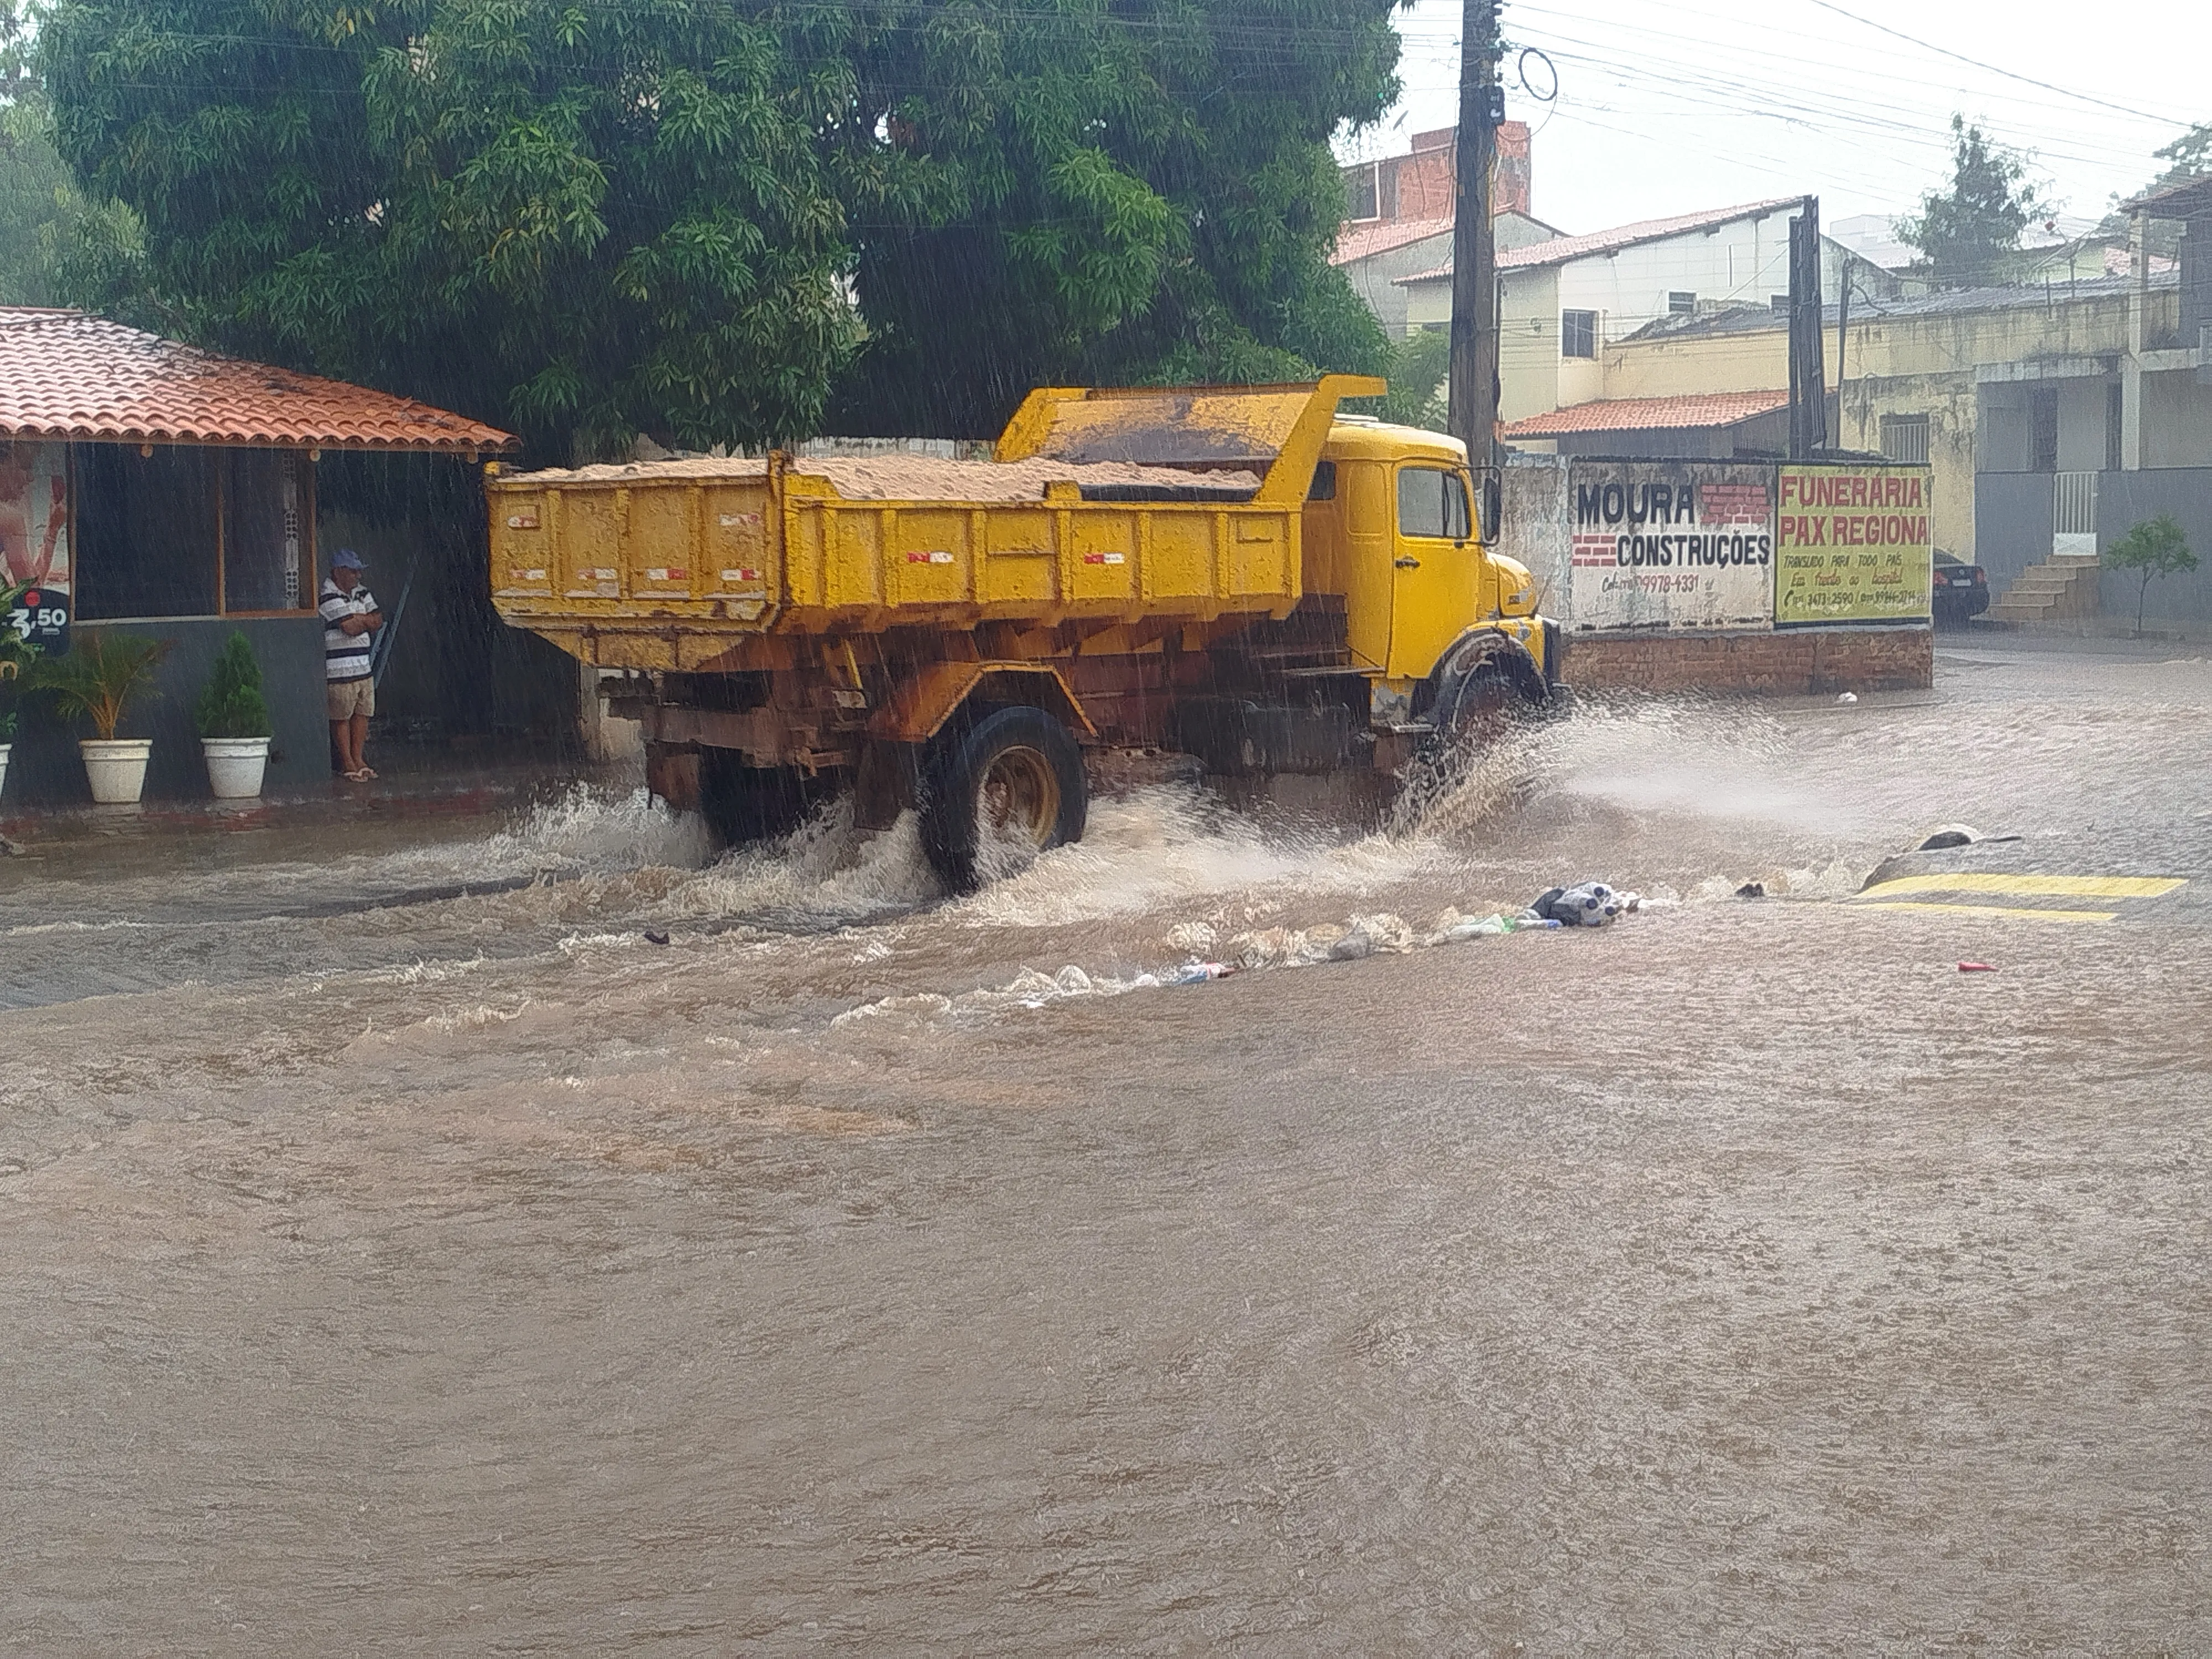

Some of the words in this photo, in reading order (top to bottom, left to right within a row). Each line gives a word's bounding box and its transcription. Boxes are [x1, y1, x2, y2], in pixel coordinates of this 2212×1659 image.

[1578, 484, 1694, 524] MOURA
[1780, 515, 1827, 546] PAX
[1618, 529, 1770, 569] CONSTRUÇÕES
[1858, 554, 1878, 567] TODO
